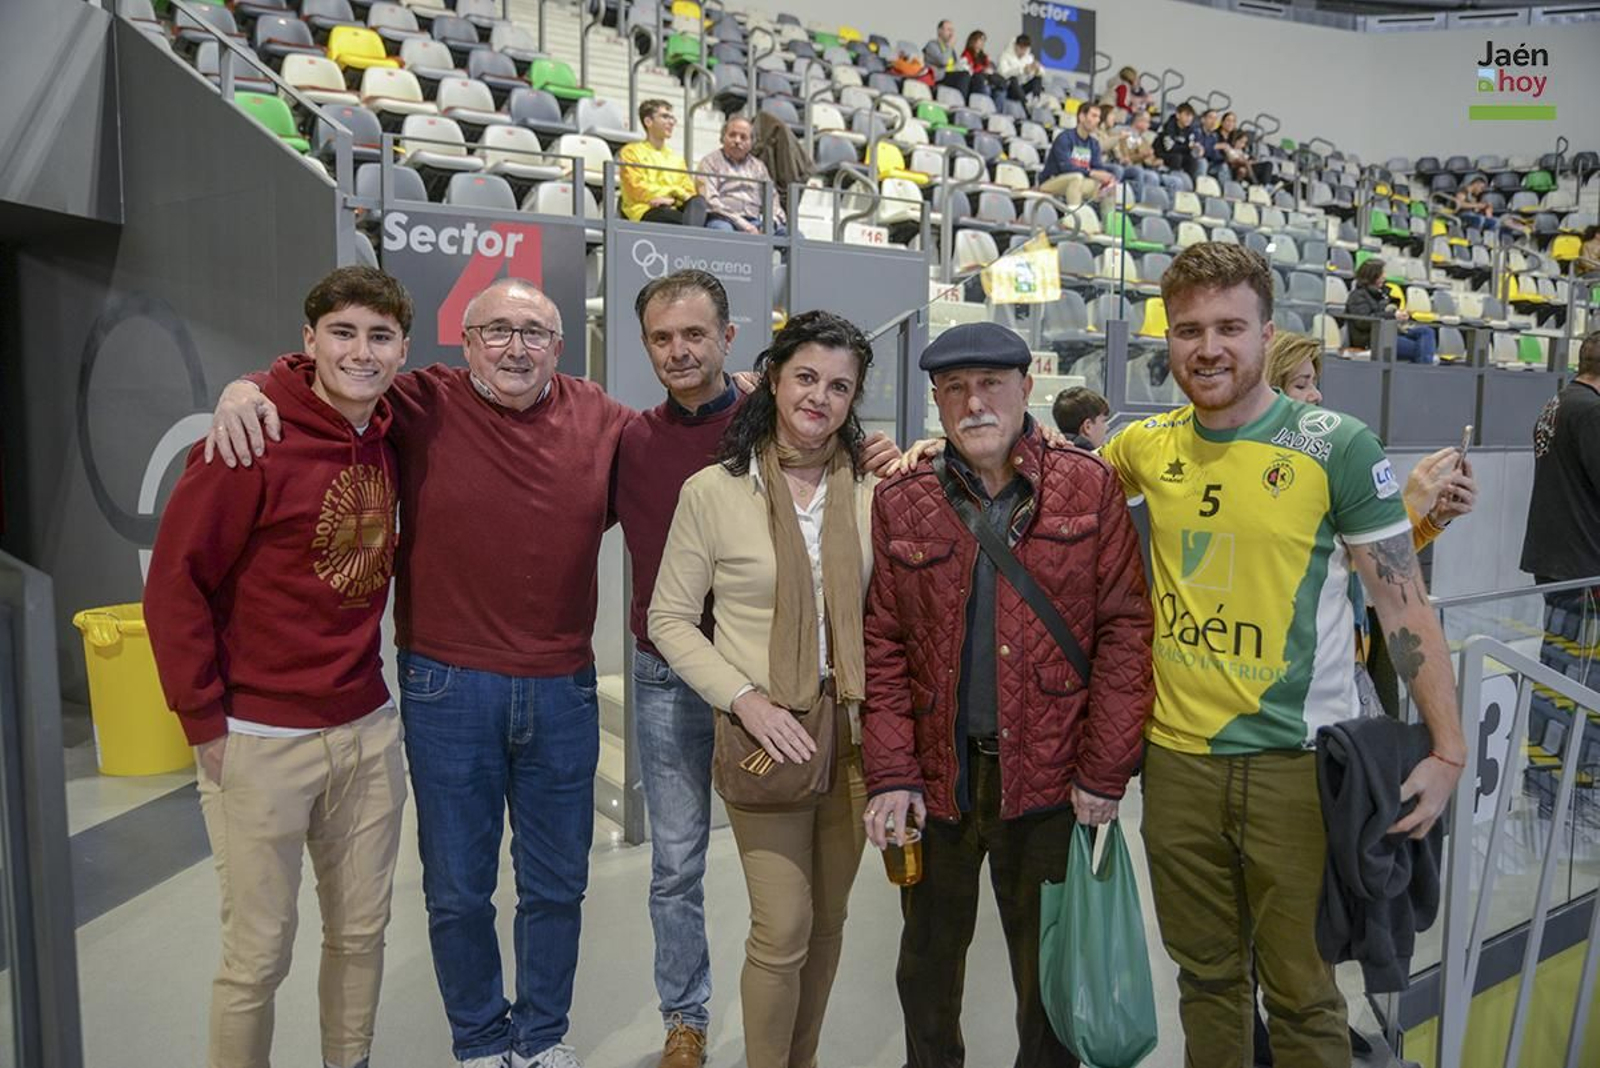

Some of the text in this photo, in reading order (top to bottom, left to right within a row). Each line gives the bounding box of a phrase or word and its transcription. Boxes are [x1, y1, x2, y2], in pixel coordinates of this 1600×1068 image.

[1041, 3, 1080, 72] 5
[383, 212, 524, 258] Sector
[673, 255, 752, 275] olivo arena
[1271, 427, 1333, 461] JADISA
[311, 488, 340, 549] DON'T
[1198, 484, 1222, 517] 5
